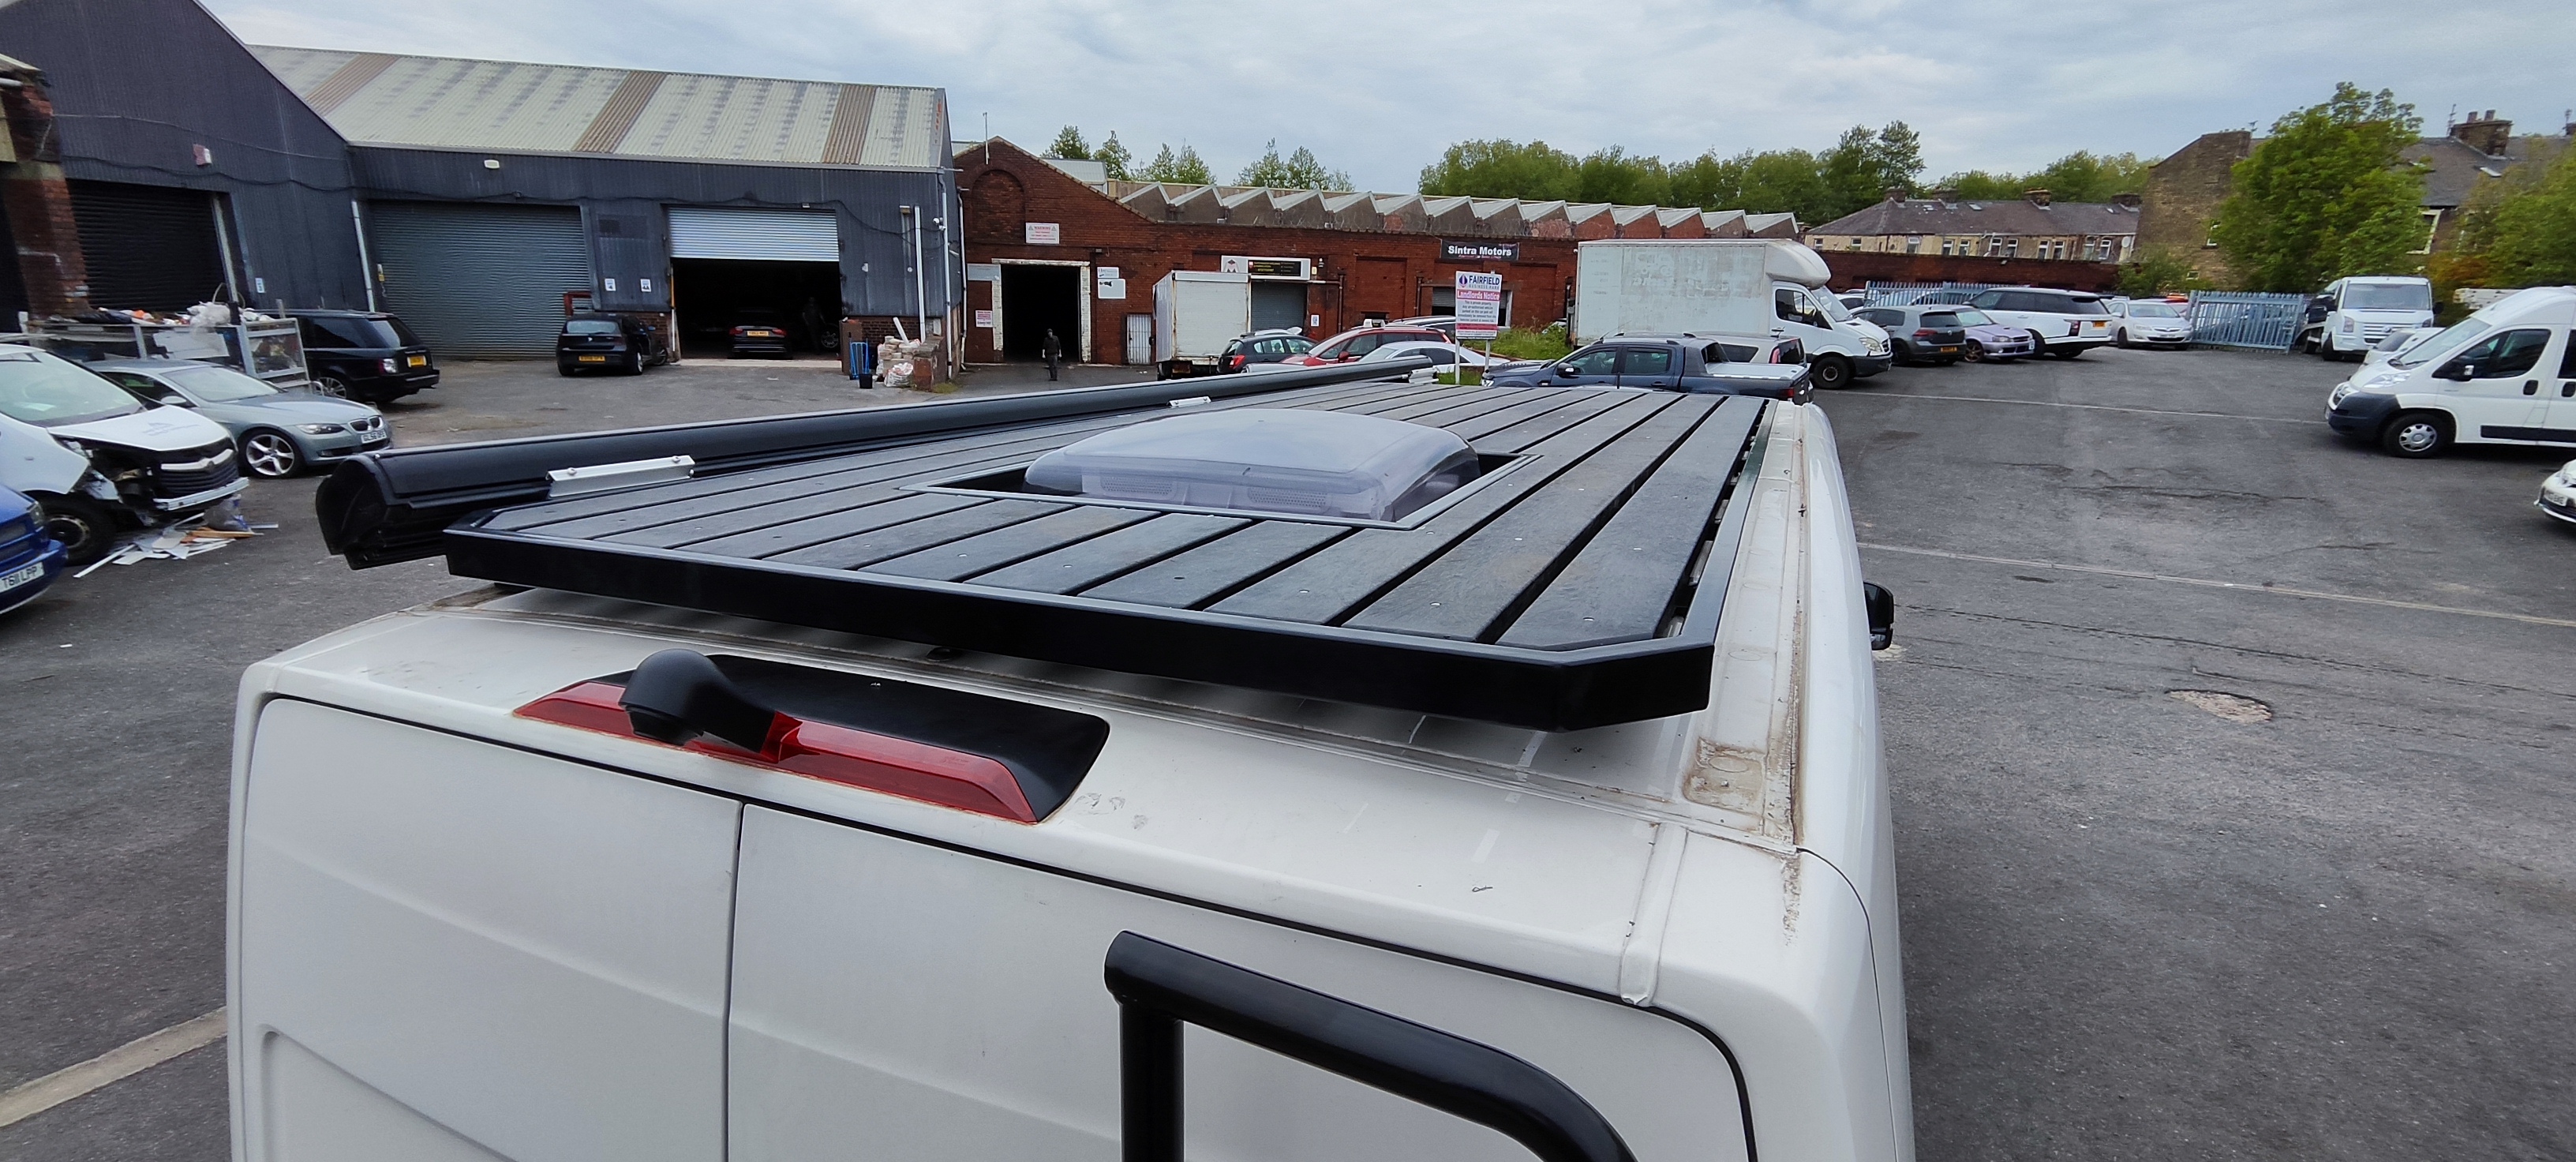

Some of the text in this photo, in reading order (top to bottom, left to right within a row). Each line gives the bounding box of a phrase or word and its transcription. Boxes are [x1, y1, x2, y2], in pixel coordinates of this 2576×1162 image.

[1447, 246, 1511, 256] Sintra Motors
[1469, 276, 1500, 285] FAIRFIELD
[1457, 290, 1482, 299] Landlords
